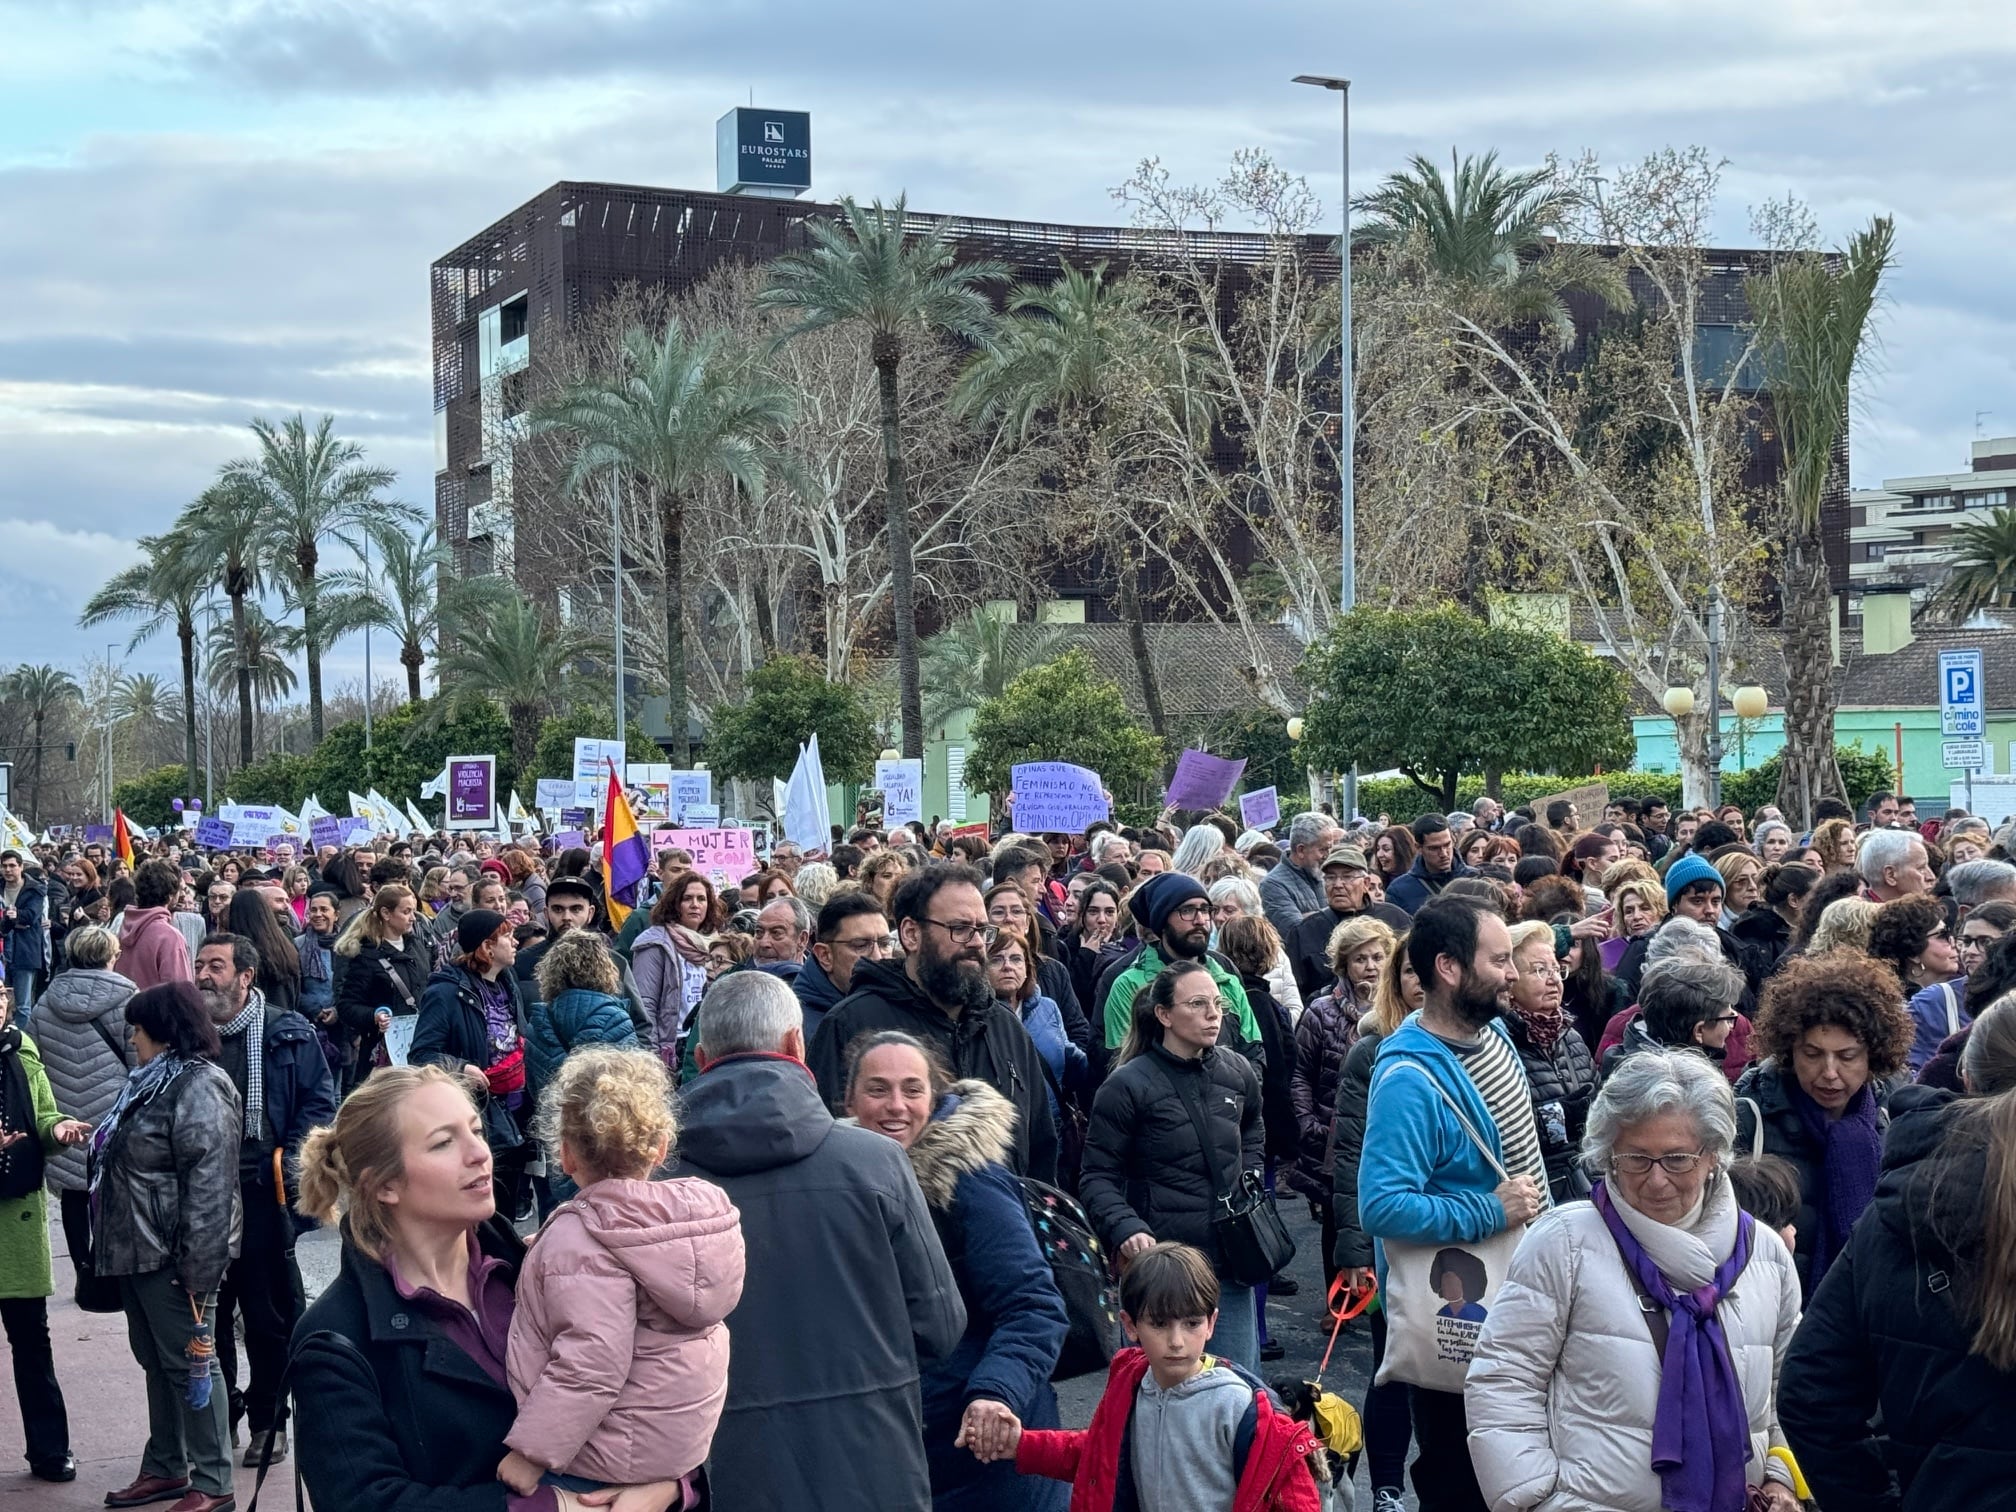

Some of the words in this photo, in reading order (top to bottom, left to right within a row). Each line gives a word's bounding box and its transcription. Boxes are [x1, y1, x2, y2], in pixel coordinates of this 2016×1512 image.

[741, 144, 808, 158] EUROSTARS
[1951, 670, 1970, 701] P
[457, 770, 483, 778] VIOLENCIA
[1017, 765, 1047, 774] OPINAS
[1049, 765, 1066, 773] QUE
[1015, 776, 1076, 790] FEMINISMO
[1081, 783, 1094, 792] NO
[897, 788, 913, 803] YA!
[1017, 792, 1030, 800] TE
[1089, 793, 1100, 802] TE
[653, 832, 674, 845] LA
[688, 831, 750, 850] MUJER
